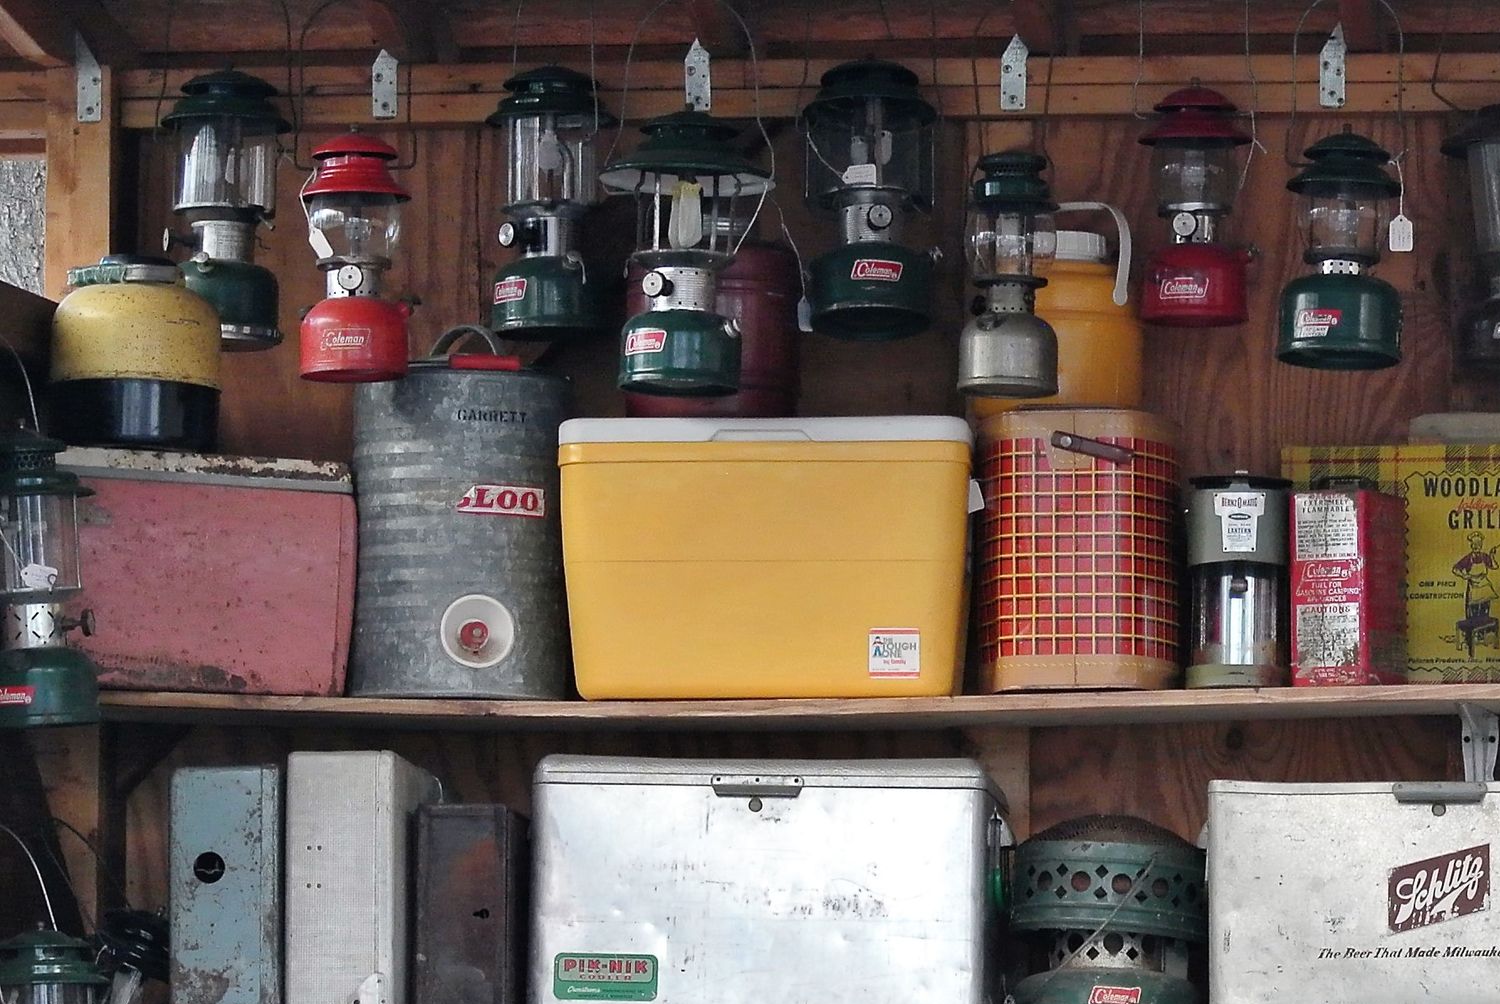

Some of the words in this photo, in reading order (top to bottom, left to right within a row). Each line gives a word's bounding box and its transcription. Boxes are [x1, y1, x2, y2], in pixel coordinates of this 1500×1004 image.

[858, 262, 892, 277] Coleman
[1164, 282, 1198, 295] Coleman
[325, 331, 365, 345] Coleman
[1394, 853, 1485, 925] Schlitz
[1317, 947, 1342, 960] The
[1343, 947, 1373, 959] Beer
[1374, 946, 1401, 959] That
[1405, 946, 1441, 959] Made
[564, 958, 649, 975] PIK-NIK
[1094, 988, 1129, 1004] Coleman
